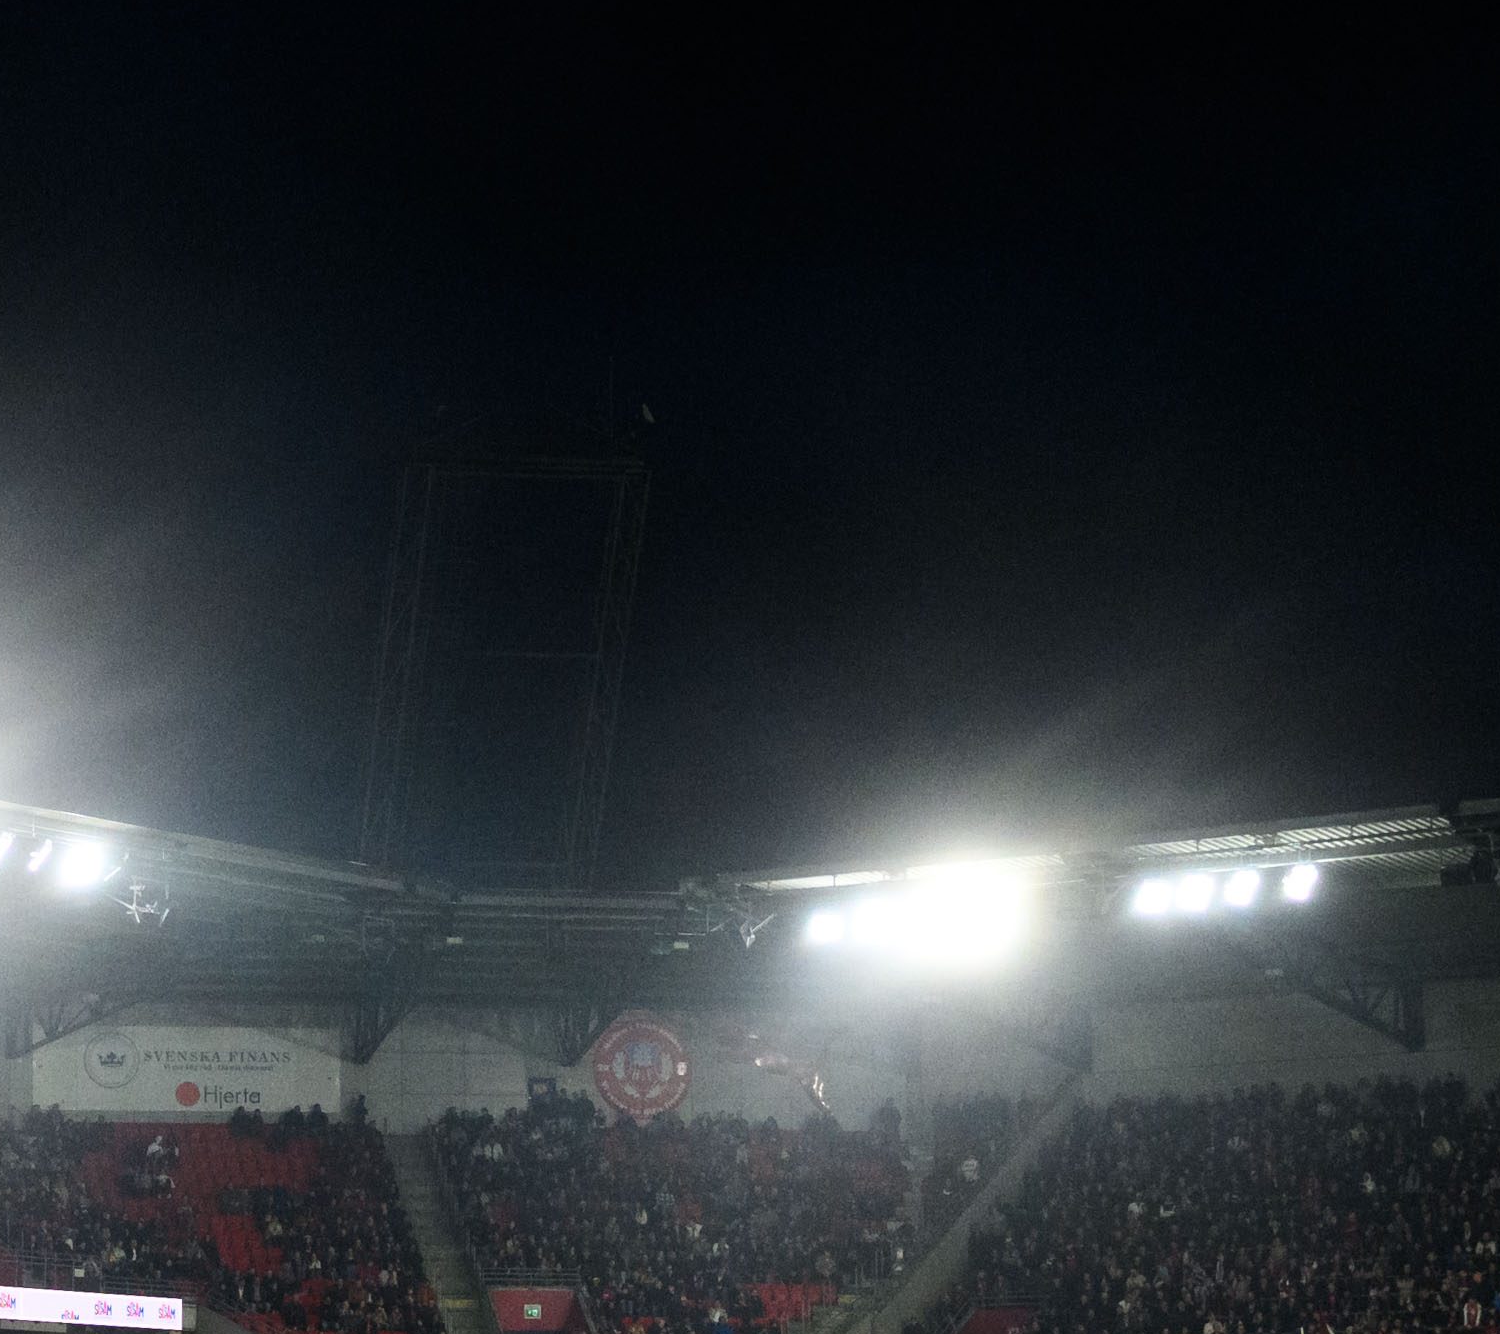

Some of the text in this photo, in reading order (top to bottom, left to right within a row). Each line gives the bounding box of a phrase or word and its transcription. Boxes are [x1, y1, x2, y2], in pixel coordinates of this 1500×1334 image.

[143, 1051, 292, 1064] SVENSKA FINANS
[203, 1085, 261, 1109] Hjerta
